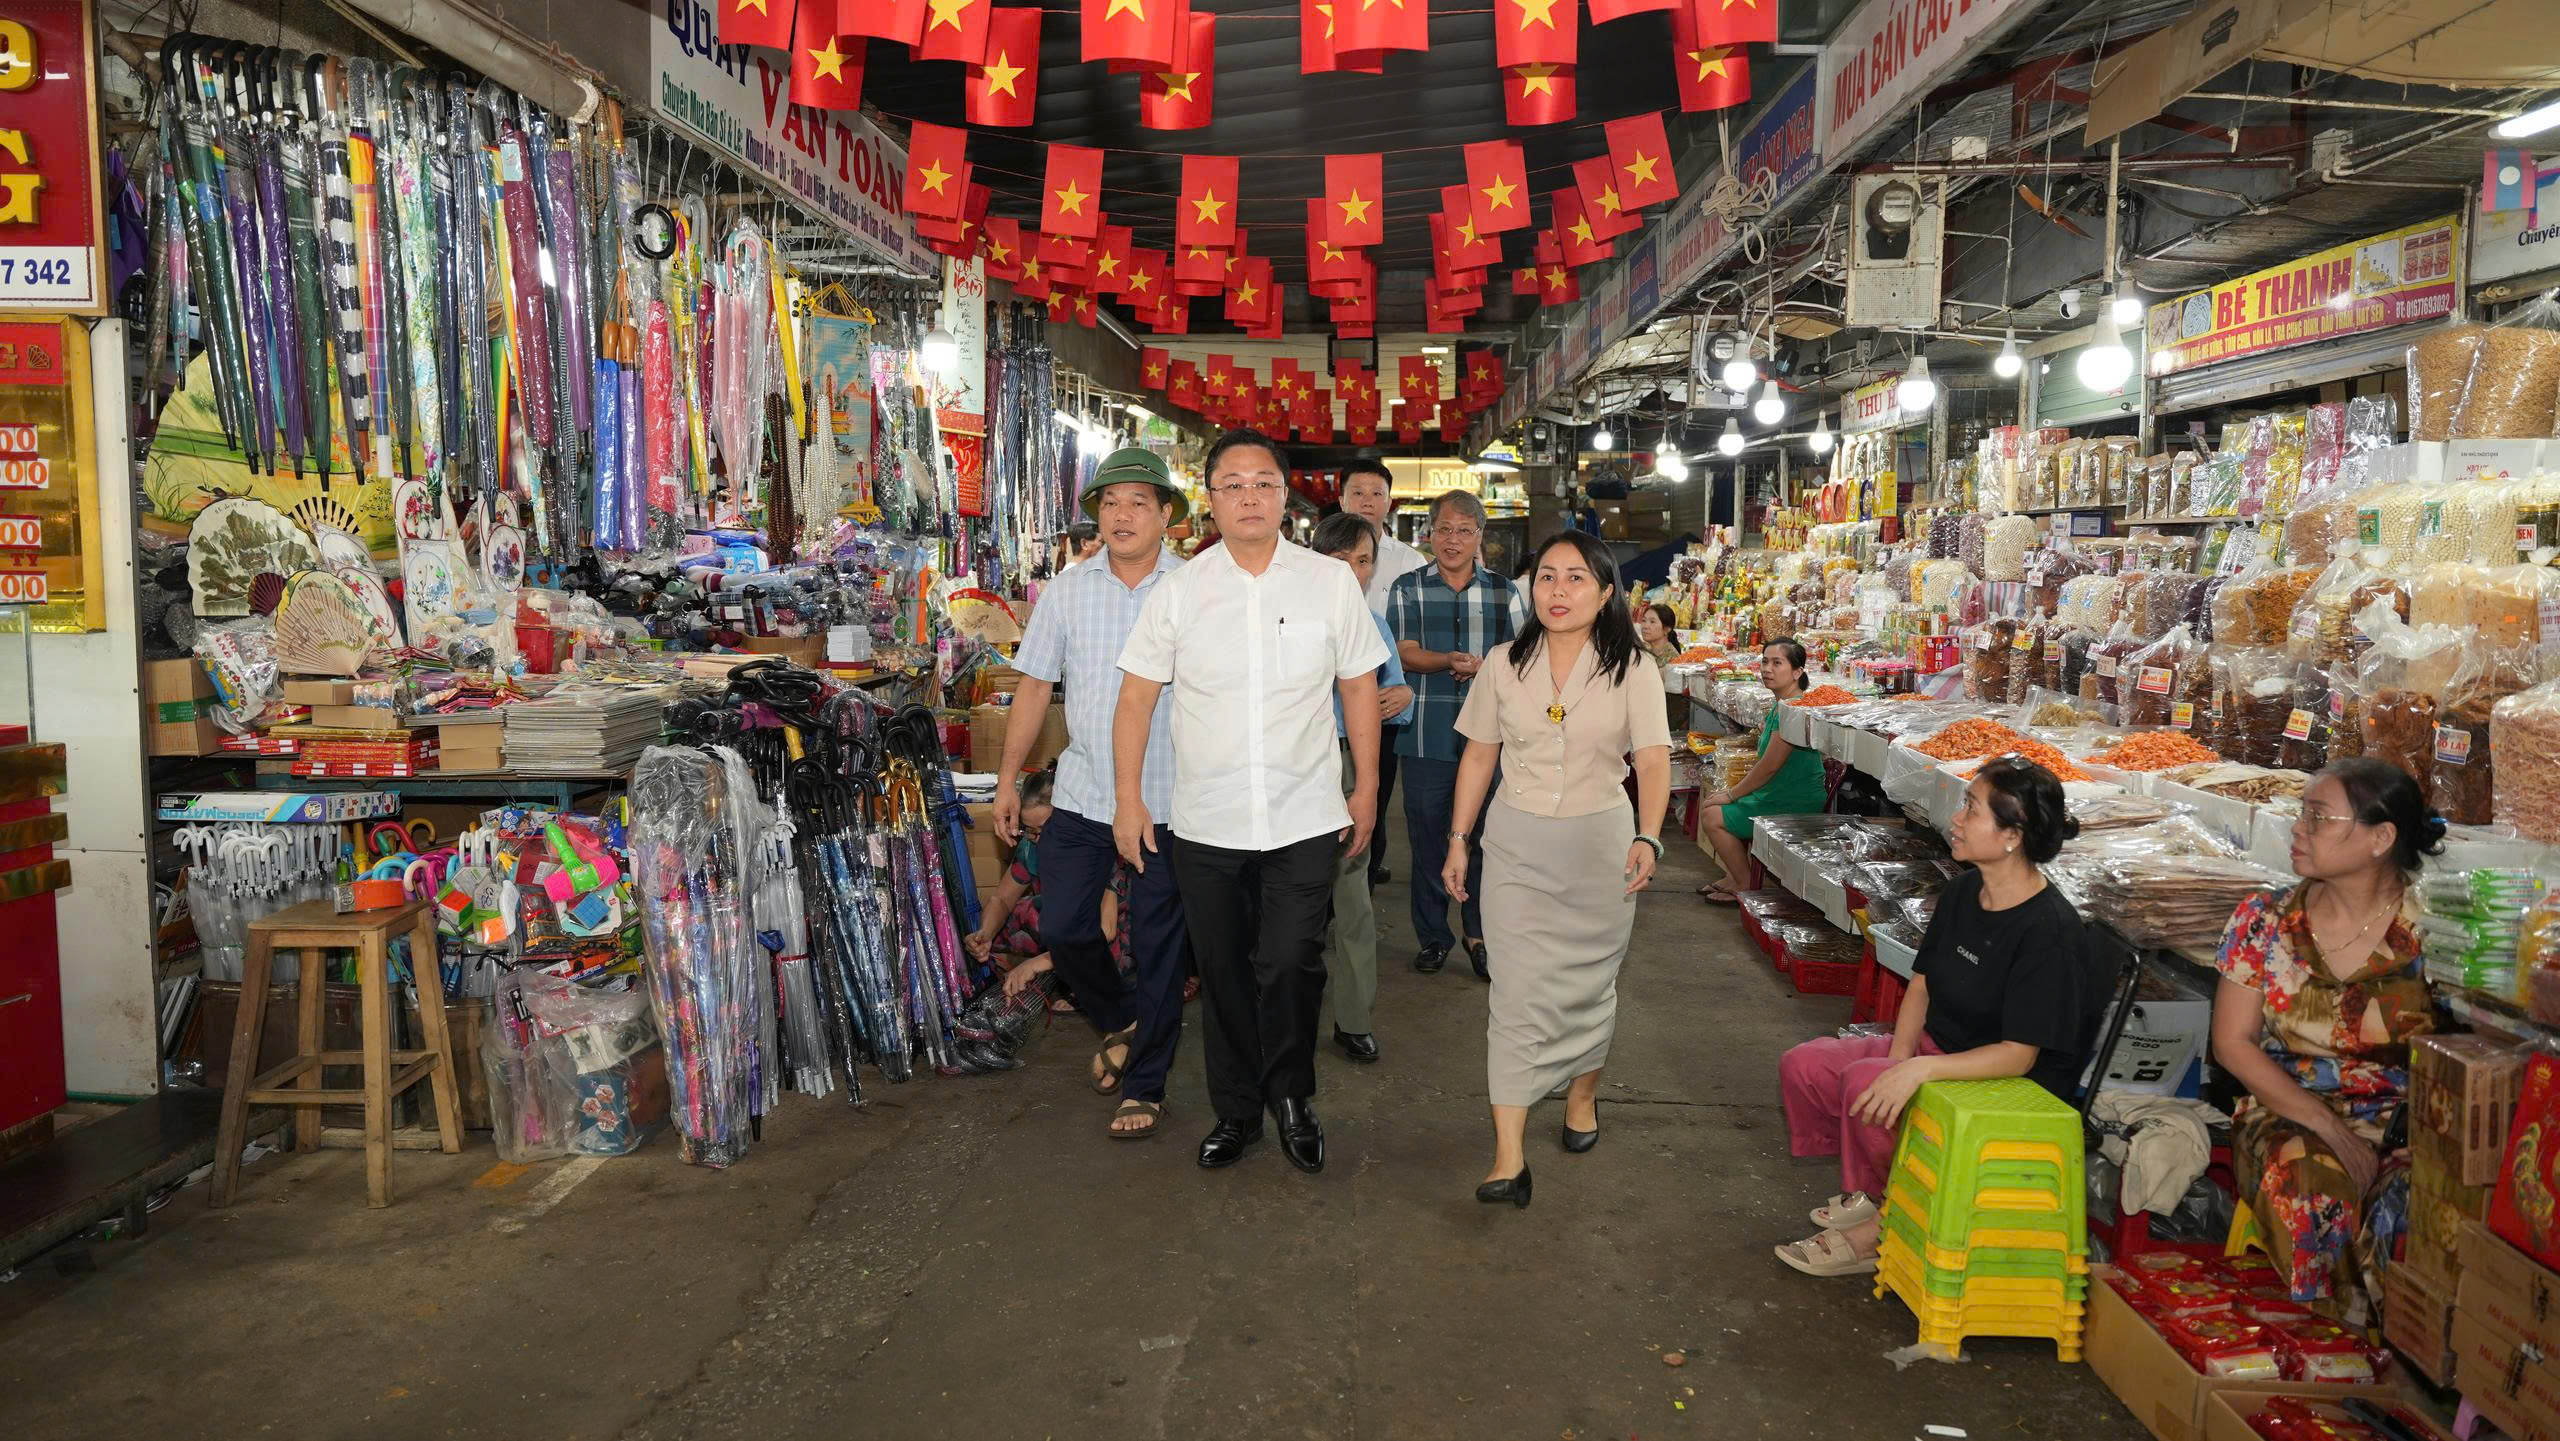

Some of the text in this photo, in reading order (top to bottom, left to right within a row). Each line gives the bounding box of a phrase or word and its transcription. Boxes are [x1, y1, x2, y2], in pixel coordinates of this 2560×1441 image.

[1833, 47, 1865, 133] MUA
[1870, 0, 1909, 99] BÁN
[662, 70, 689, 120] Chuyên
[689, 89, 705, 131] Mua
[706, 100, 718, 140] Bán
[834, 120, 904, 222] TOÀN
[24, 258, 71, 285] 342
[2217, 256, 2353, 330] BÉ THANH
[1857, 392, 1883, 419] THU
[1956, 944, 1980, 966] CHANEL
